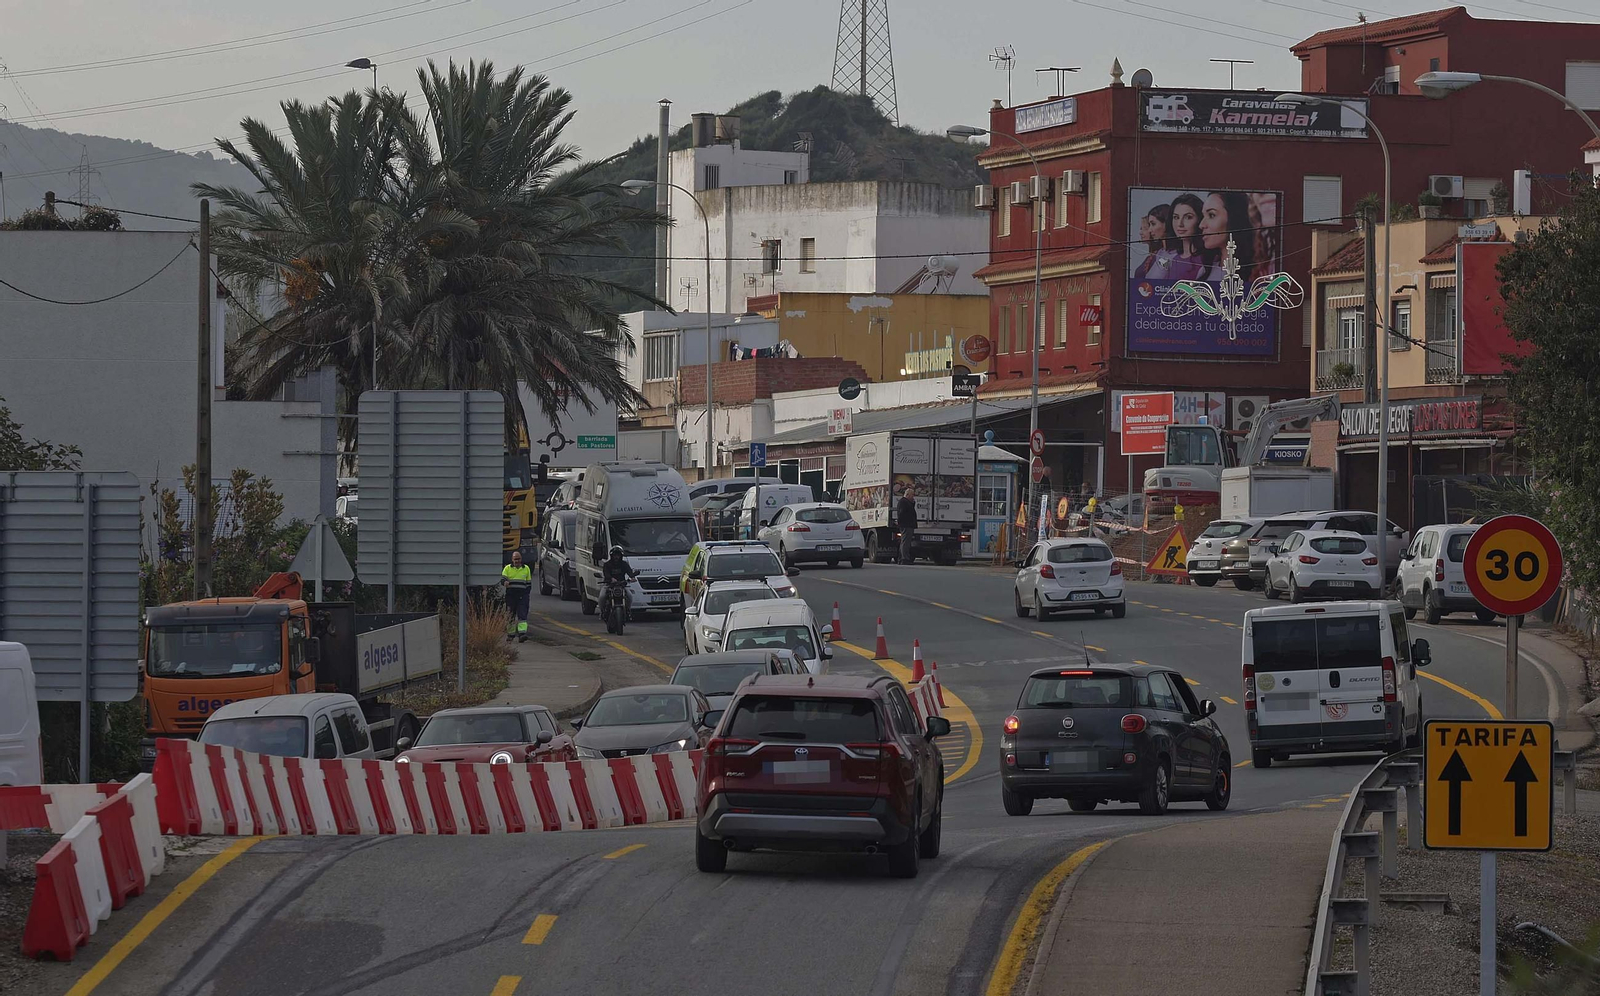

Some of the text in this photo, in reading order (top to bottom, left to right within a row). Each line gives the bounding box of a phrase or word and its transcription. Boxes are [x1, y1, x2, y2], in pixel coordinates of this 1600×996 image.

[1208, 108, 1310, 126] Karmela
[1080, 308, 1099, 324] illy
[1135, 302, 1184, 316] Expertas
[1135, 318, 1192, 331] dedicadas
[1195, 321, 1202, 331] a
[1205, 320, 1217, 332] tu
[1217, 339, 1232, 347] 956
[1234, 339, 1249, 347] 090
[1173, 396, 1197, 413] 24H
[1341, 407, 1369, 436] SALON
[1369, 407, 1380, 435] DE
[1413, 404, 1430, 432] LOS
[1432, 400, 1478, 431] PASTORES
[1485, 548, 1540, 582] 30
[364, 643, 399, 674] algesa
[1435, 727, 1538, 747] TARIFA
